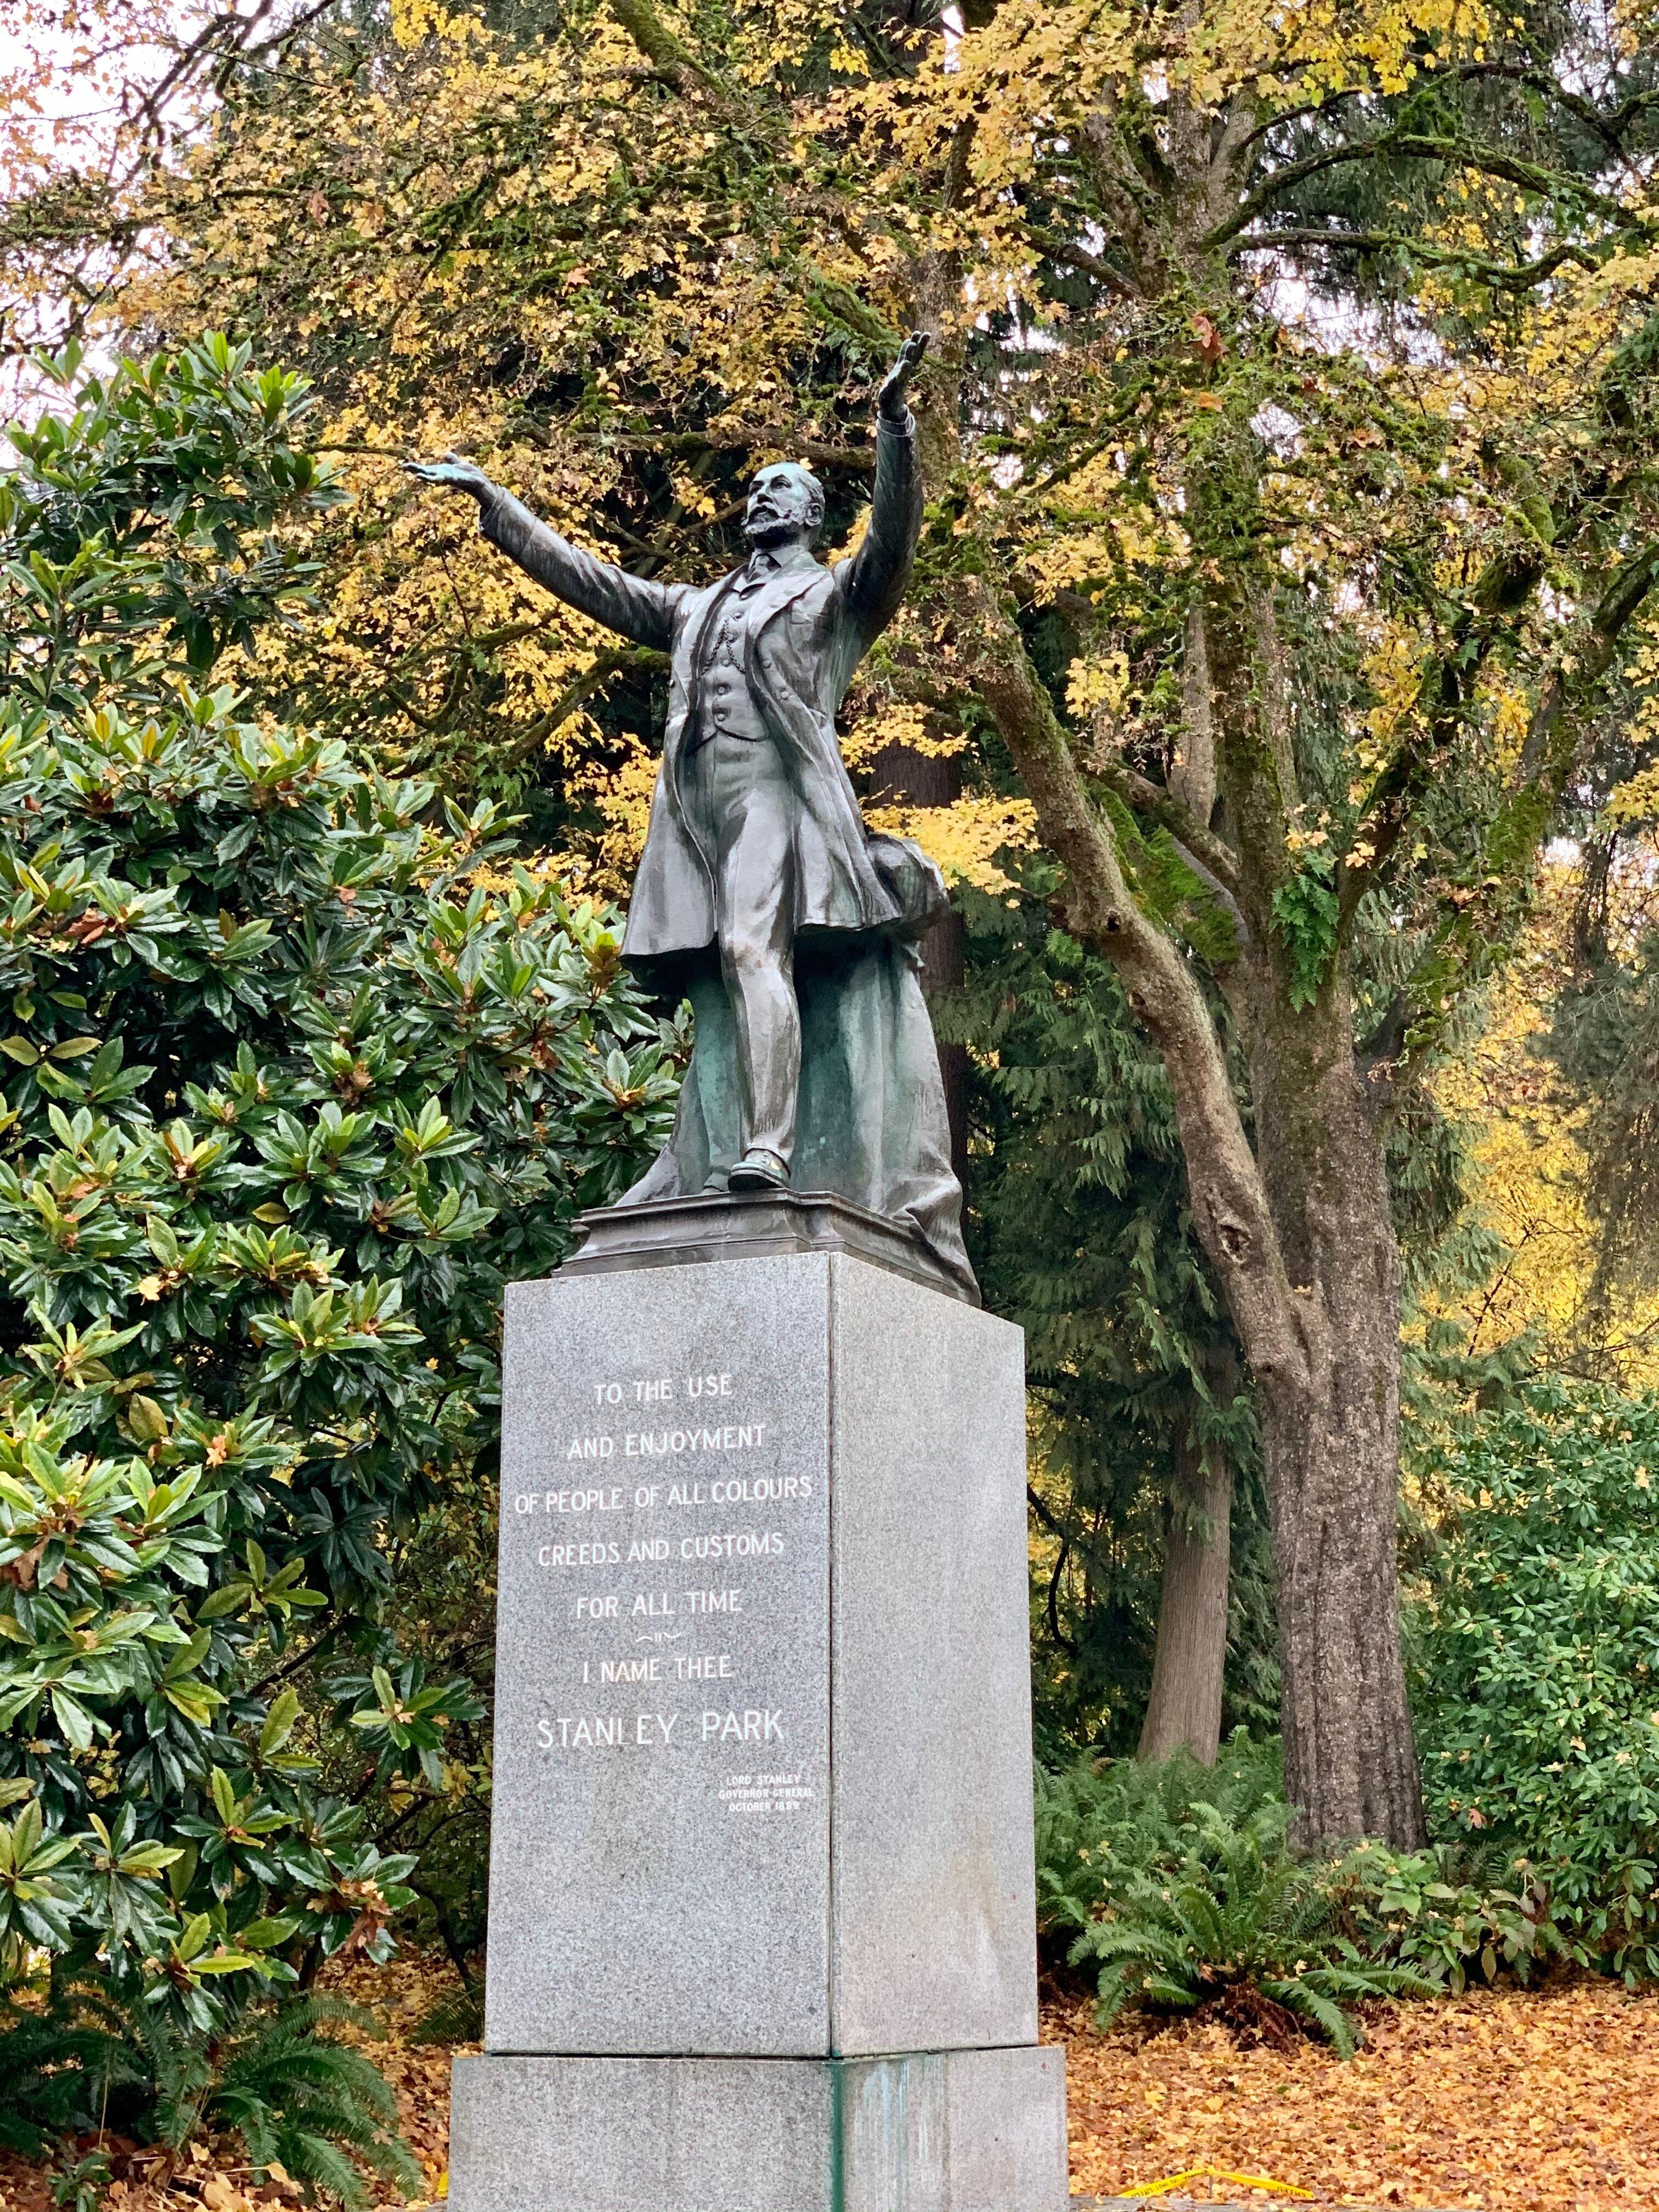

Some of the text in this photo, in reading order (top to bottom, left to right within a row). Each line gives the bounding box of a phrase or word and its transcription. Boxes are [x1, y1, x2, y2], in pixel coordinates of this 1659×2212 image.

[595, 1375, 732, 1405] TO THE USE
[567, 1425, 766, 1460] AND ENJOYMENT
[515, 1475, 812, 1514] OF PEOPLE OF ALL COLOURS
[538, 1531, 785, 1567] CREEDS AND CUSTOMS
[577, 1589, 742, 1619] FOR ALL TIME
[583, 1655, 732, 1684] I NAME THEE
[536, 1709, 785, 1749] STANLEY PARK
[719, 1787, 814, 1799] GOVERNOR GENERAL
[727, 1774, 801, 1786] LORD STANLEY
[729, 1801, 799, 1812] OCTOBER 1889
